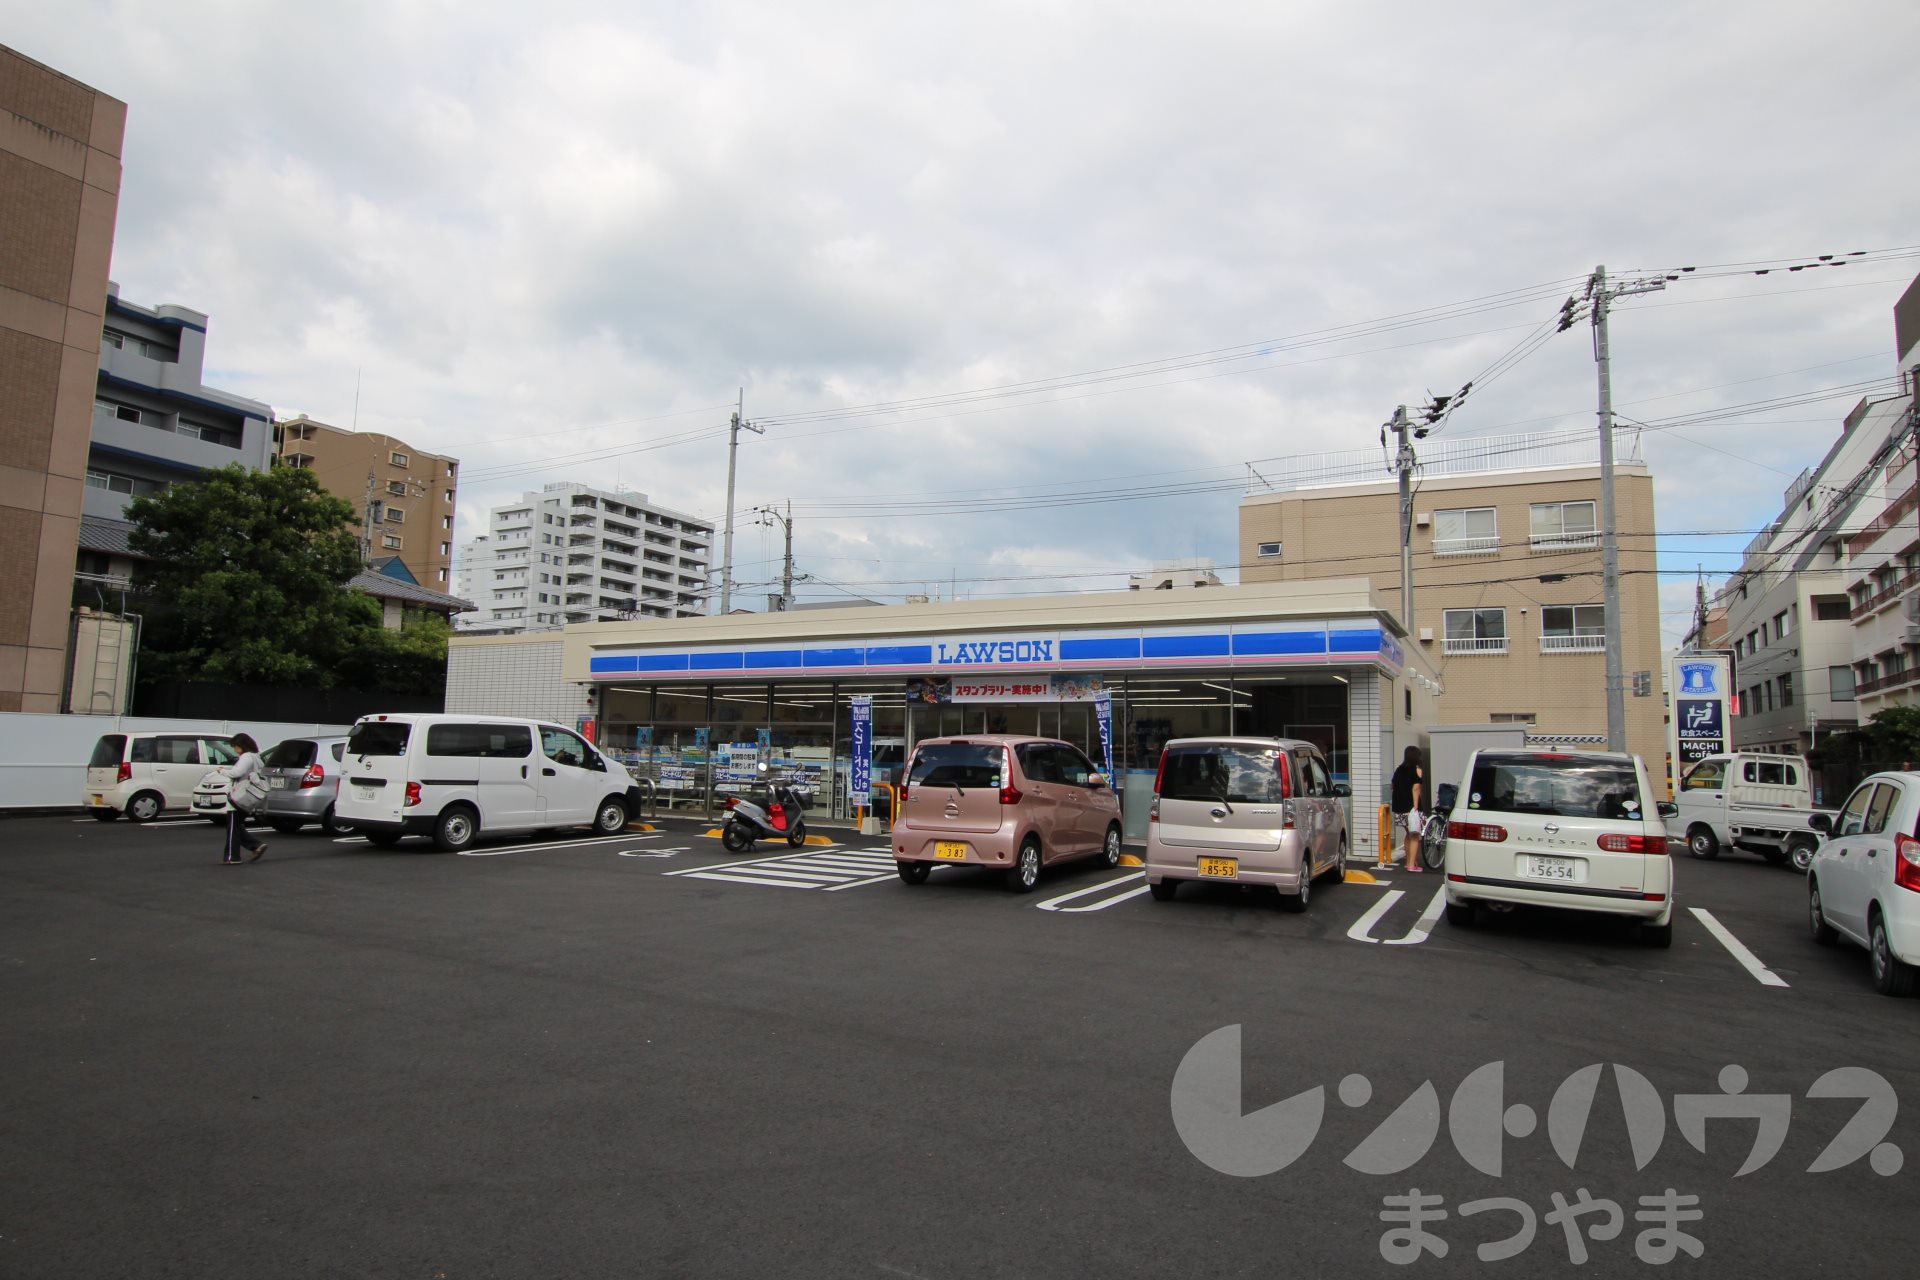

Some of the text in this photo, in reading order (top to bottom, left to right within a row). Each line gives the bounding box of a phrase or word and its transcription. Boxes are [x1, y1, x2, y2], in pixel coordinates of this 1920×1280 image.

[938, 640, 1053, 664] LAWSON
[955, 684, 1048, 696] スタンプラリー実施中!
[1680, 729, 1721, 737] 飲食スペース
[1682, 742, 1718, 750] MACHI
[1517, 836, 1588, 846] LAFESTA
[1207, 865, 1234, 877] 85-53
[1538, 865, 1573, 879] 56-54
